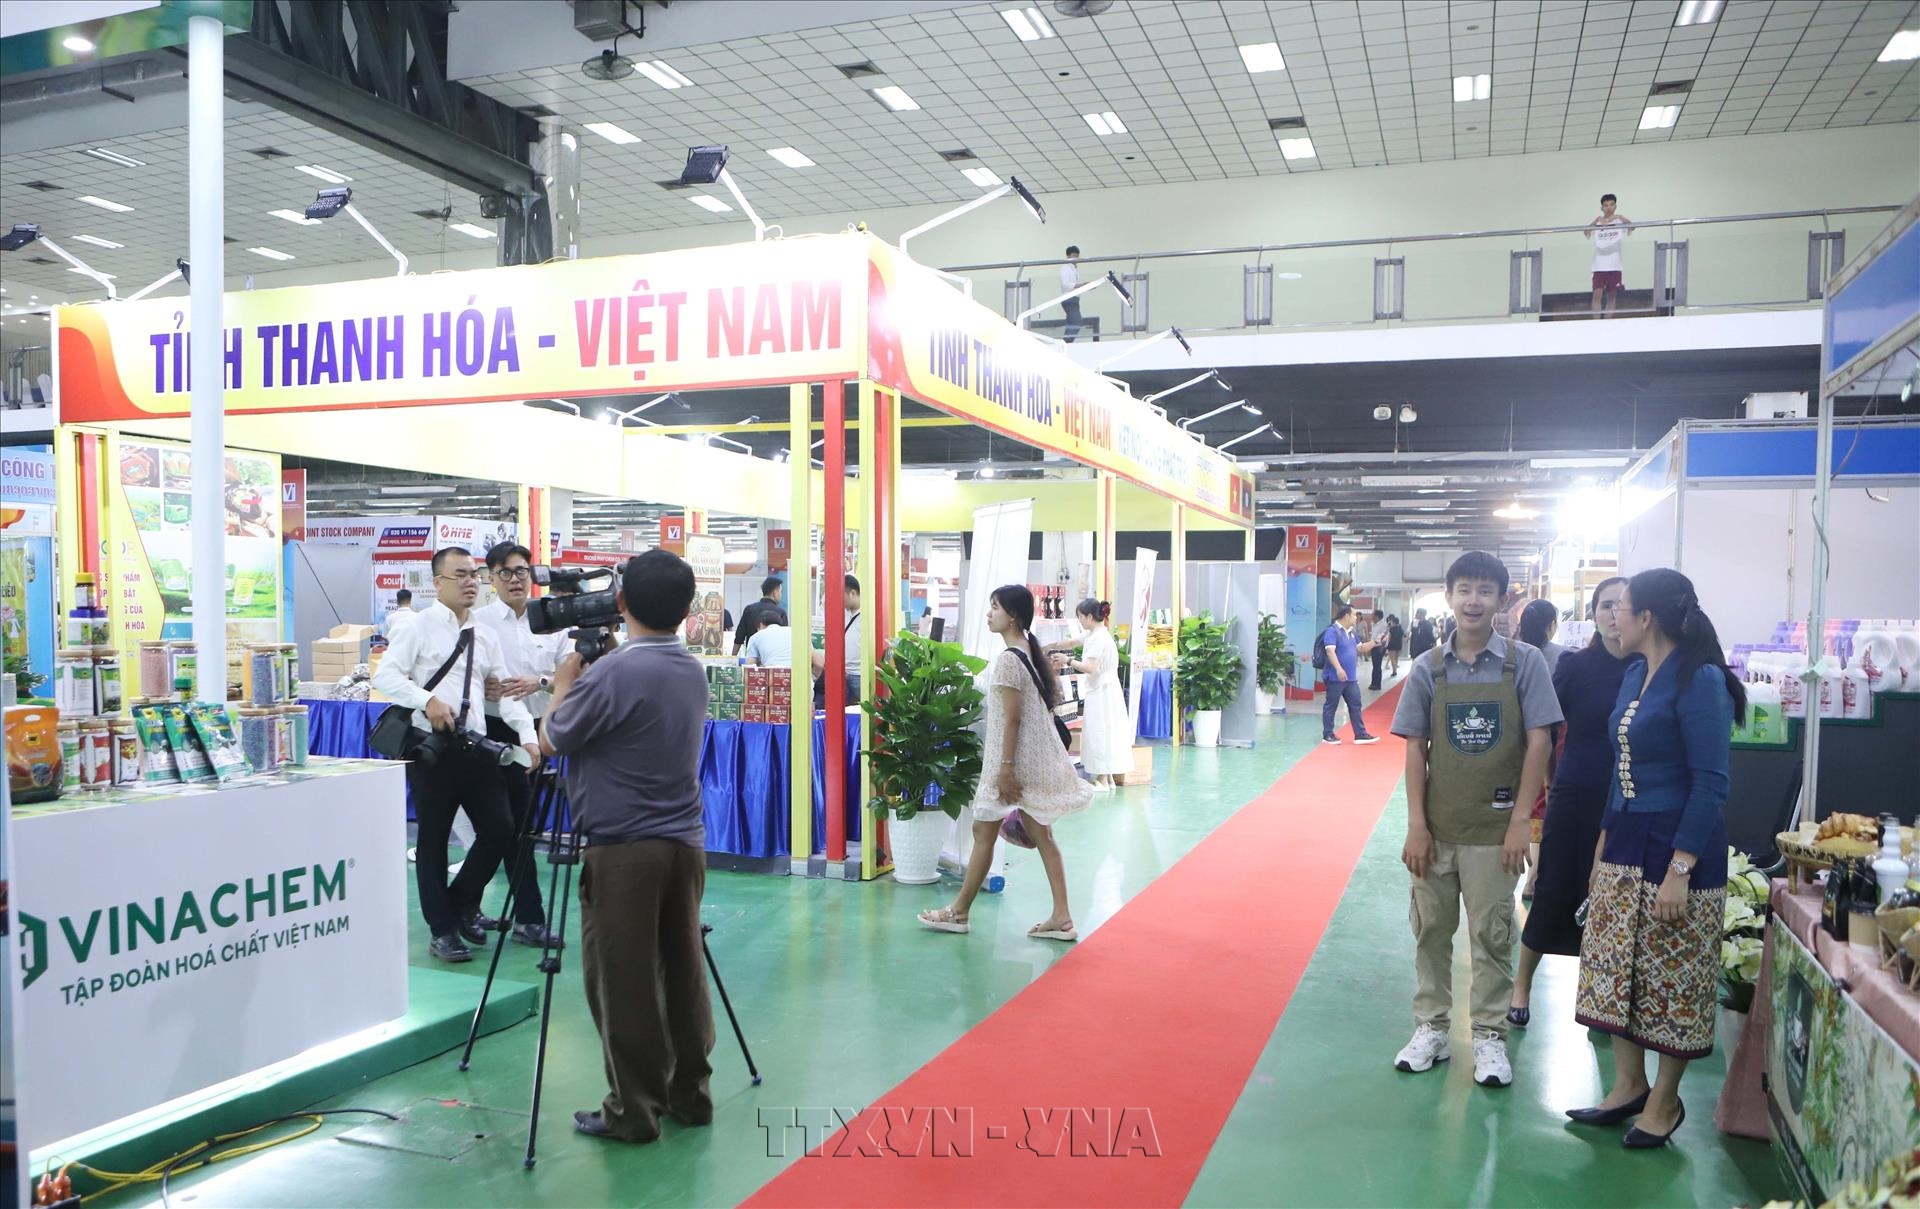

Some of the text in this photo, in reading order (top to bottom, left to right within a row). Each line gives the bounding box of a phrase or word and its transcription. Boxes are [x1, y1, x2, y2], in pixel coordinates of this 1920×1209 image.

[150, 279, 842, 394] TỈH THANH HÓA - VIỆT NAM
[2, 456, 45, 479] CÔNG
[306, 526, 375, 537] OINT STOCK COMPANY
[59, 859, 347, 963] VINACHEM
[61, 915, 349, 1006] TẬP ĐOÀN HOÁ CHẤT VIỆT NAM
